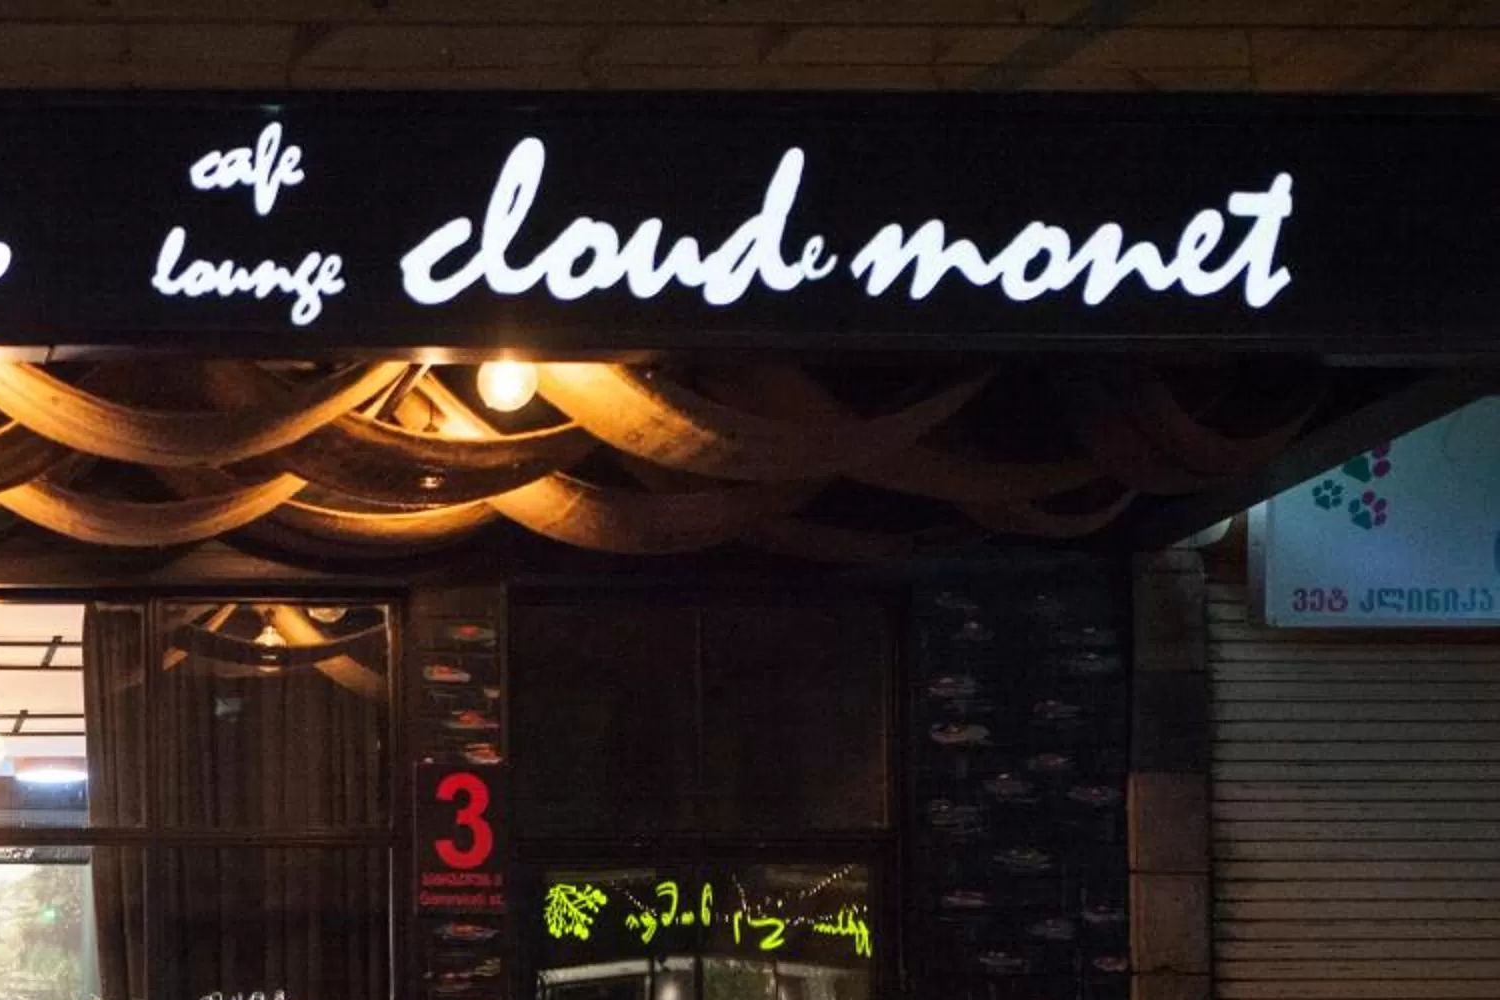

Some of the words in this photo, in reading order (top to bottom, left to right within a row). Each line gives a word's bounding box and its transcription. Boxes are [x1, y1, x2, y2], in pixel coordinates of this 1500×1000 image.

[190, 122, 305, 215] cafe
[151, 227, 345, 325] lounge
[850, 173, 1293, 308] monet
[1292, 586, 1349, 613] ვეტ
[1359, 586, 1494, 613] კლინიკა
[434, 771, 493, 869] 3
